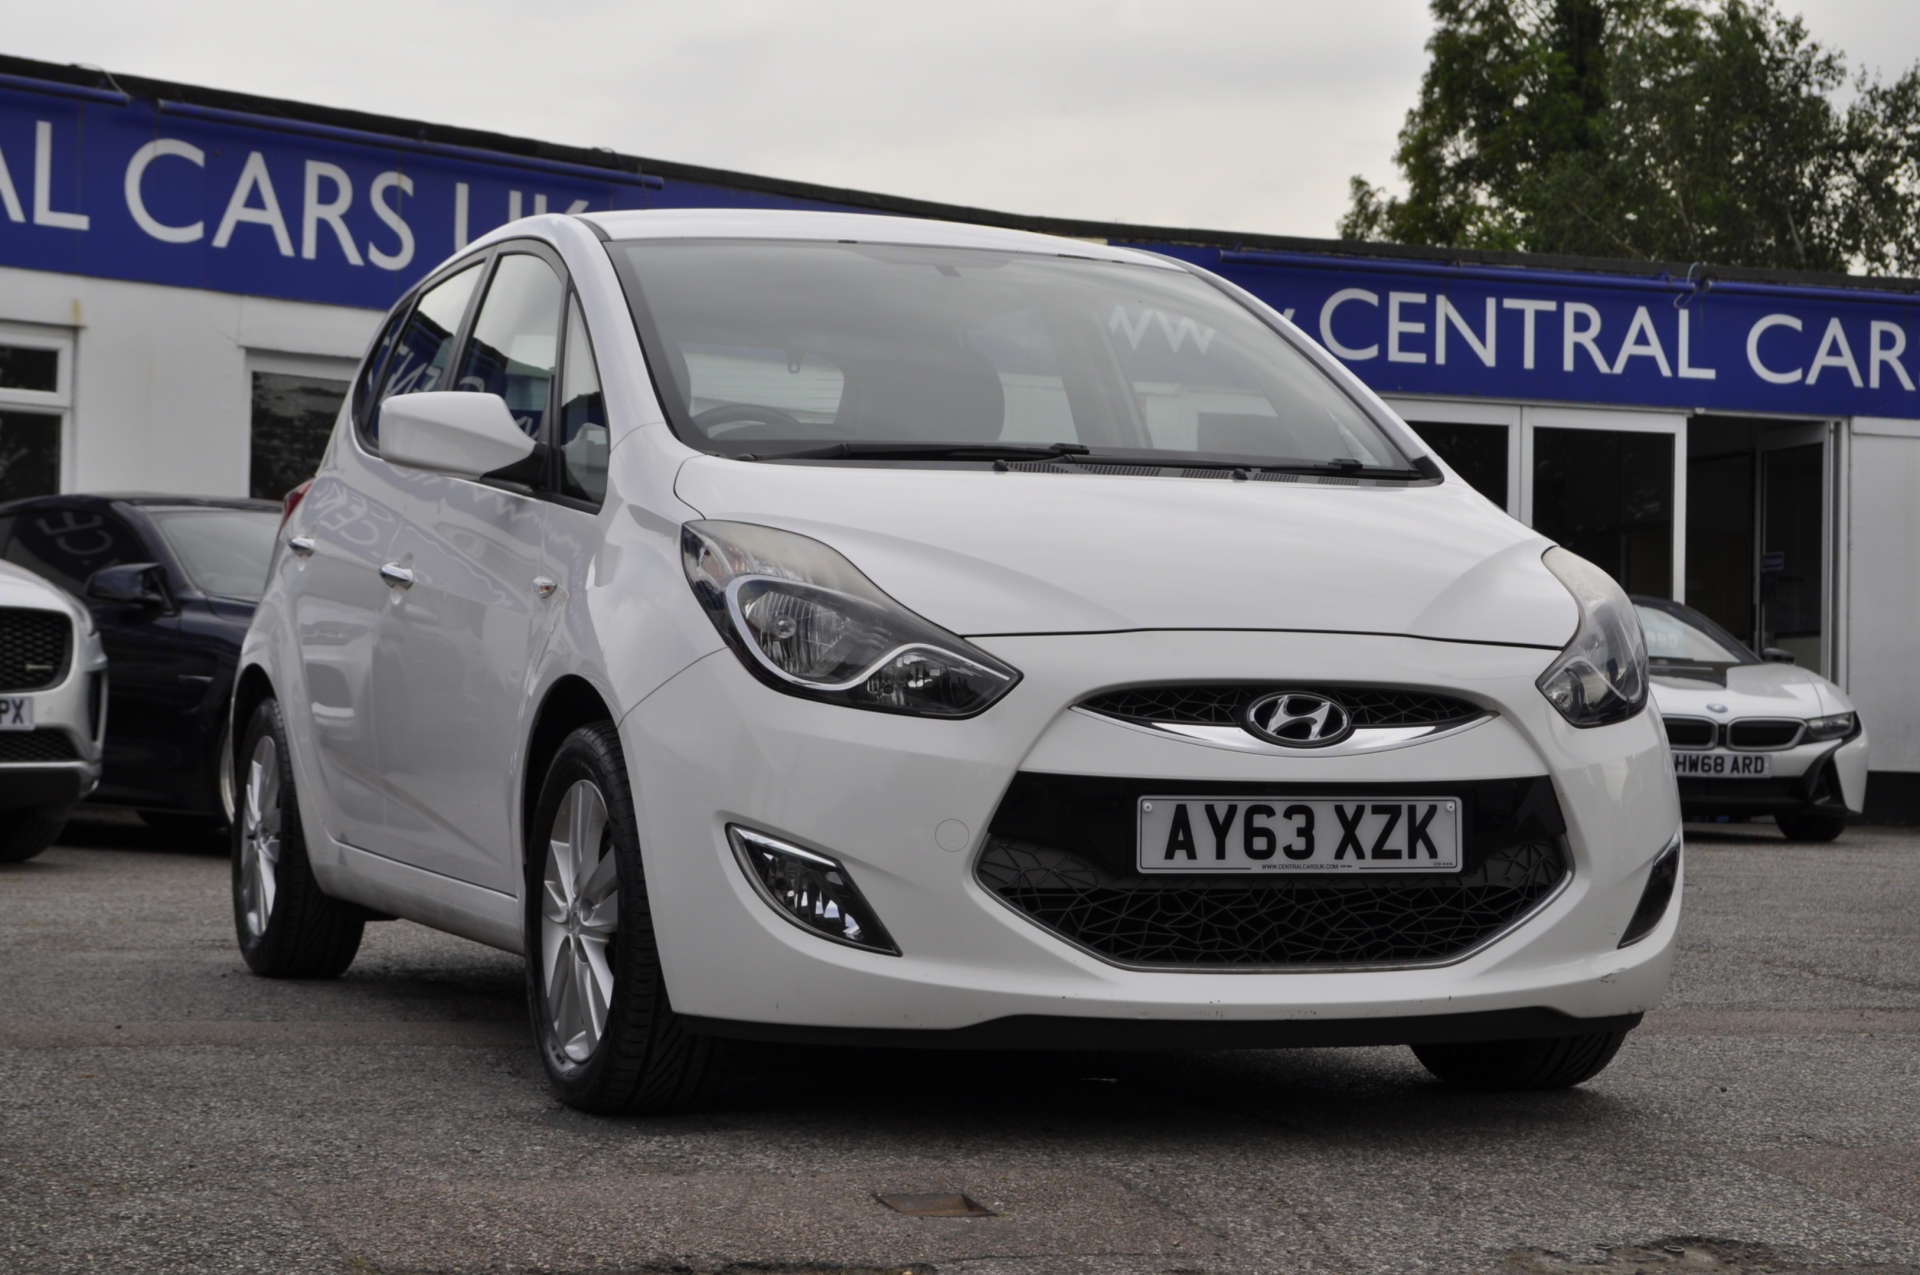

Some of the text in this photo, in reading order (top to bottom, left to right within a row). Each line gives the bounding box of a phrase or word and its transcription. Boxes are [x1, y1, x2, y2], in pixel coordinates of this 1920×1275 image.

[124, 138, 415, 271] CARS
[1319, 287, 1716, 380] CENTRAL
[1674, 754, 1765, 775] HW68 ARD
[1164, 804, 1439, 860] AY63 XZK
